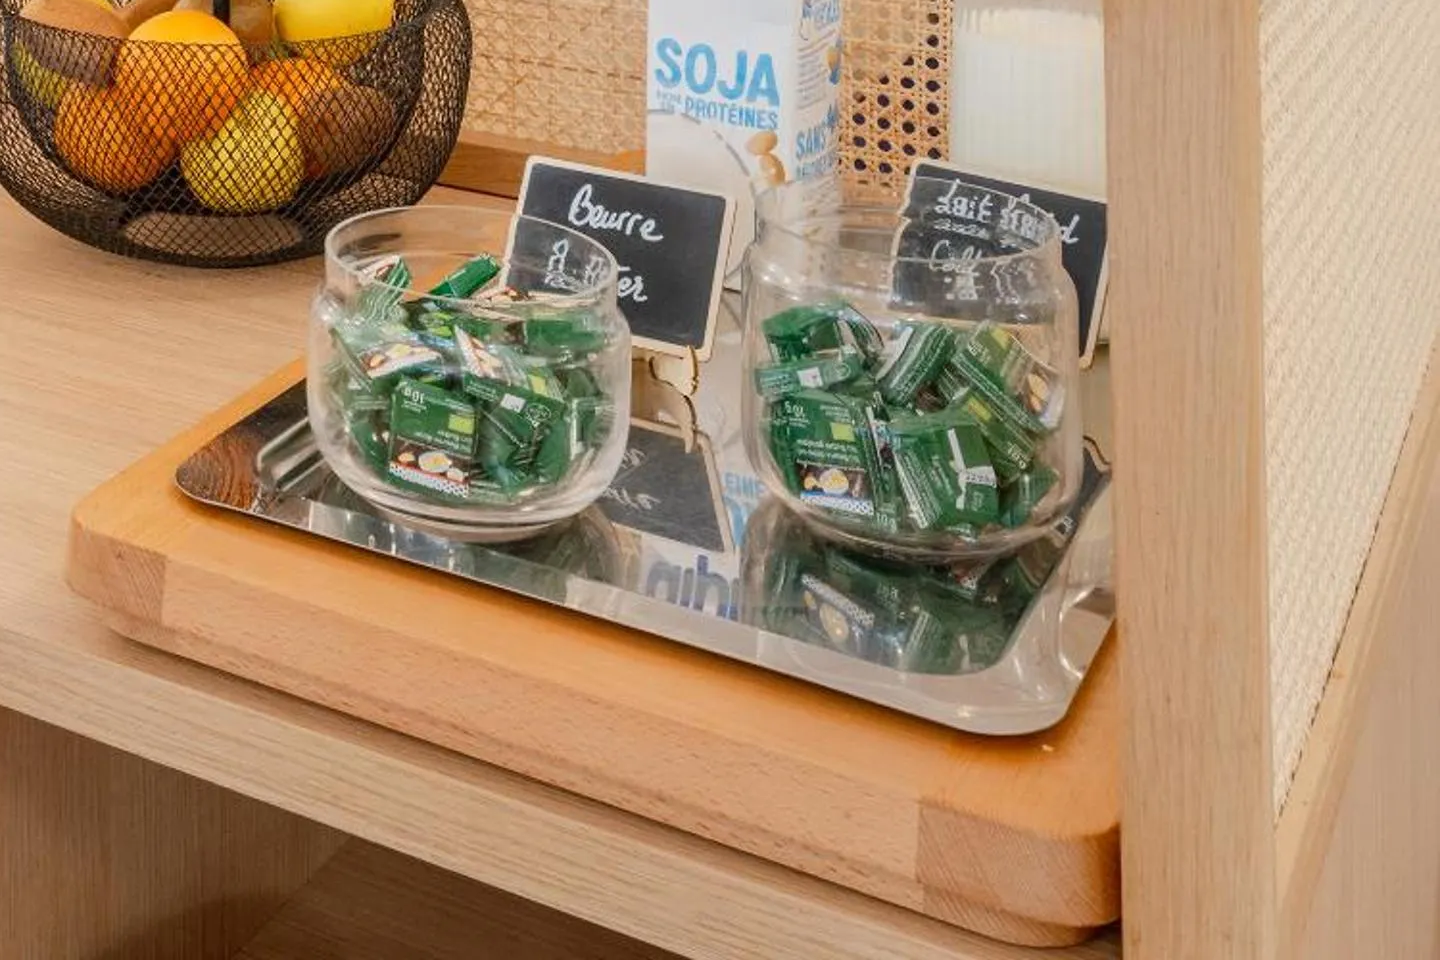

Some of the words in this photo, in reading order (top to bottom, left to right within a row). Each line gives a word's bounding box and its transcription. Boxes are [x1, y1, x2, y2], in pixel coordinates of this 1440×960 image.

[654, 37, 781, 107] SOJA
[684, 96, 778, 130] PROTÉINES
[568, 184, 664, 241] Beurre
